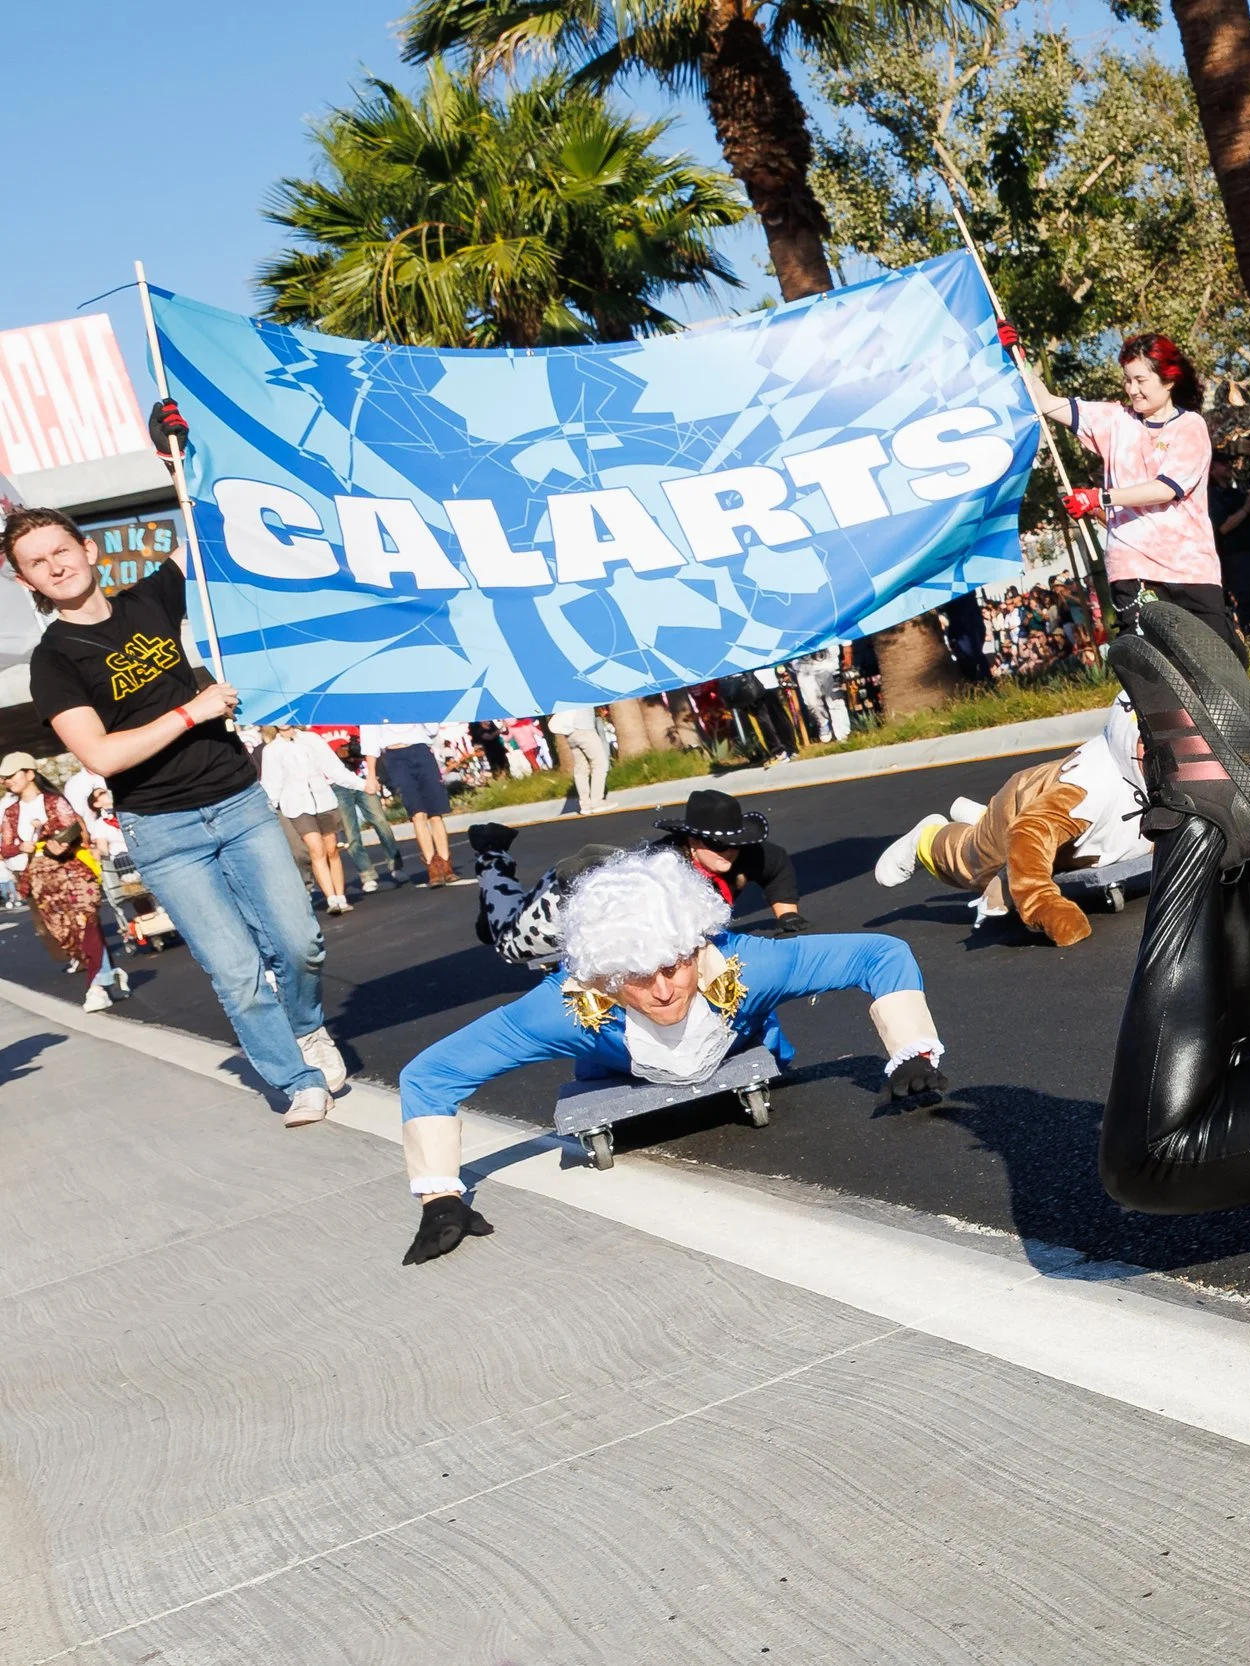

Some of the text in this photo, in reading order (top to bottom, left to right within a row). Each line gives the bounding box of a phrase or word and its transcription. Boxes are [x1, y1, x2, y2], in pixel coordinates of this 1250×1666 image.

[213, 406, 1014, 590] CALARTS
[106, 633, 163, 672] CAL
[111, 638, 181, 700] ARTS
